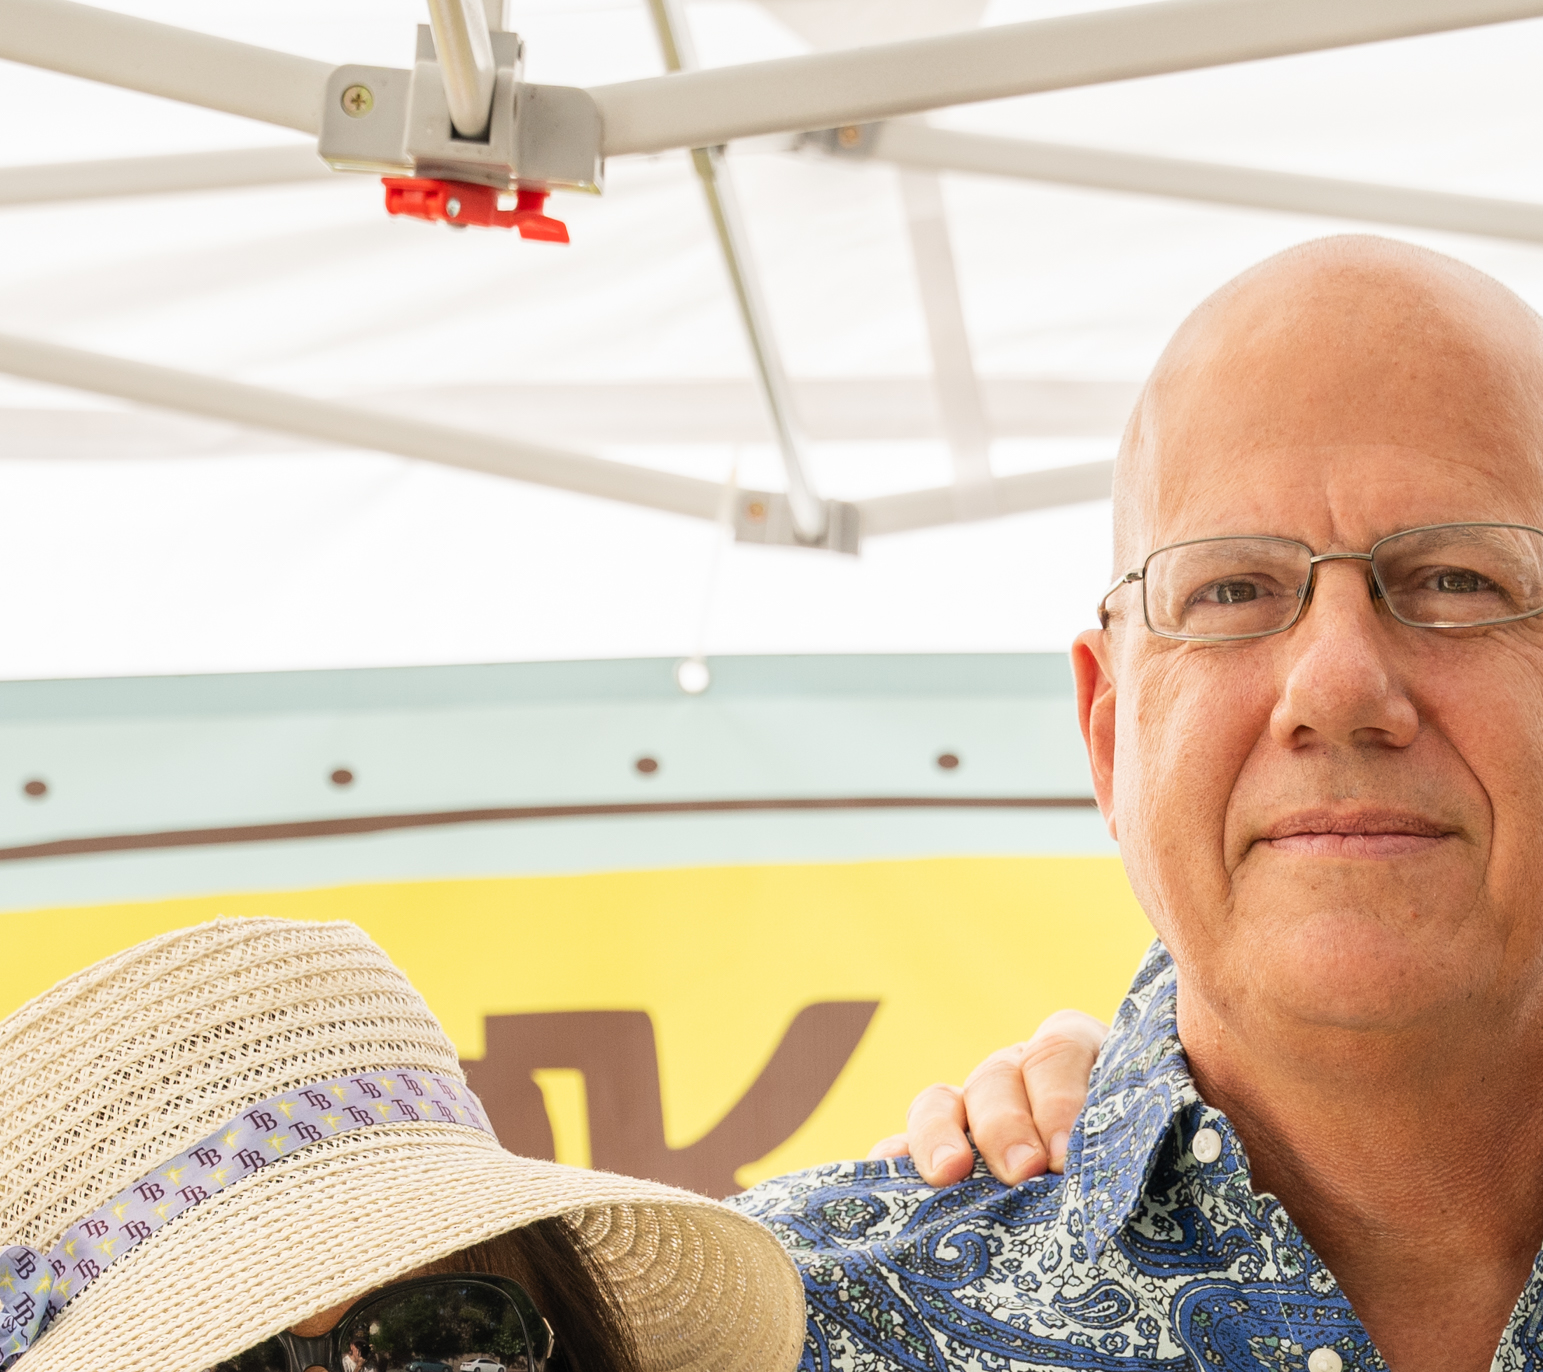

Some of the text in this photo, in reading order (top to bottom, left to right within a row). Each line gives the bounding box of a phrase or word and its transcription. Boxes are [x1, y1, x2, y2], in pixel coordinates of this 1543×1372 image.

[72, 1258, 101, 1281] TB
[119, 1220, 151, 1240] TB
[175, 1185, 208, 1204] TB
[232, 1148, 266, 1170] TB
[288, 1121, 322, 1142] TB
[342, 1105, 374, 1127] TB
[391, 1099, 419, 1121] TB
[79, 1219, 109, 1238] TB
[133, 1182, 165, 1203] TB
[189, 1147, 222, 1168] TB
[243, 1110, 278, 1132] TB
[298, 1090, 332, 1111] TB
[351, 1078, 382, 1099] TB
[397, 1074, 424, 1096] TB
[13, 1291, 36, 1327] TB
[15, 1247, 37, 1280] TB
